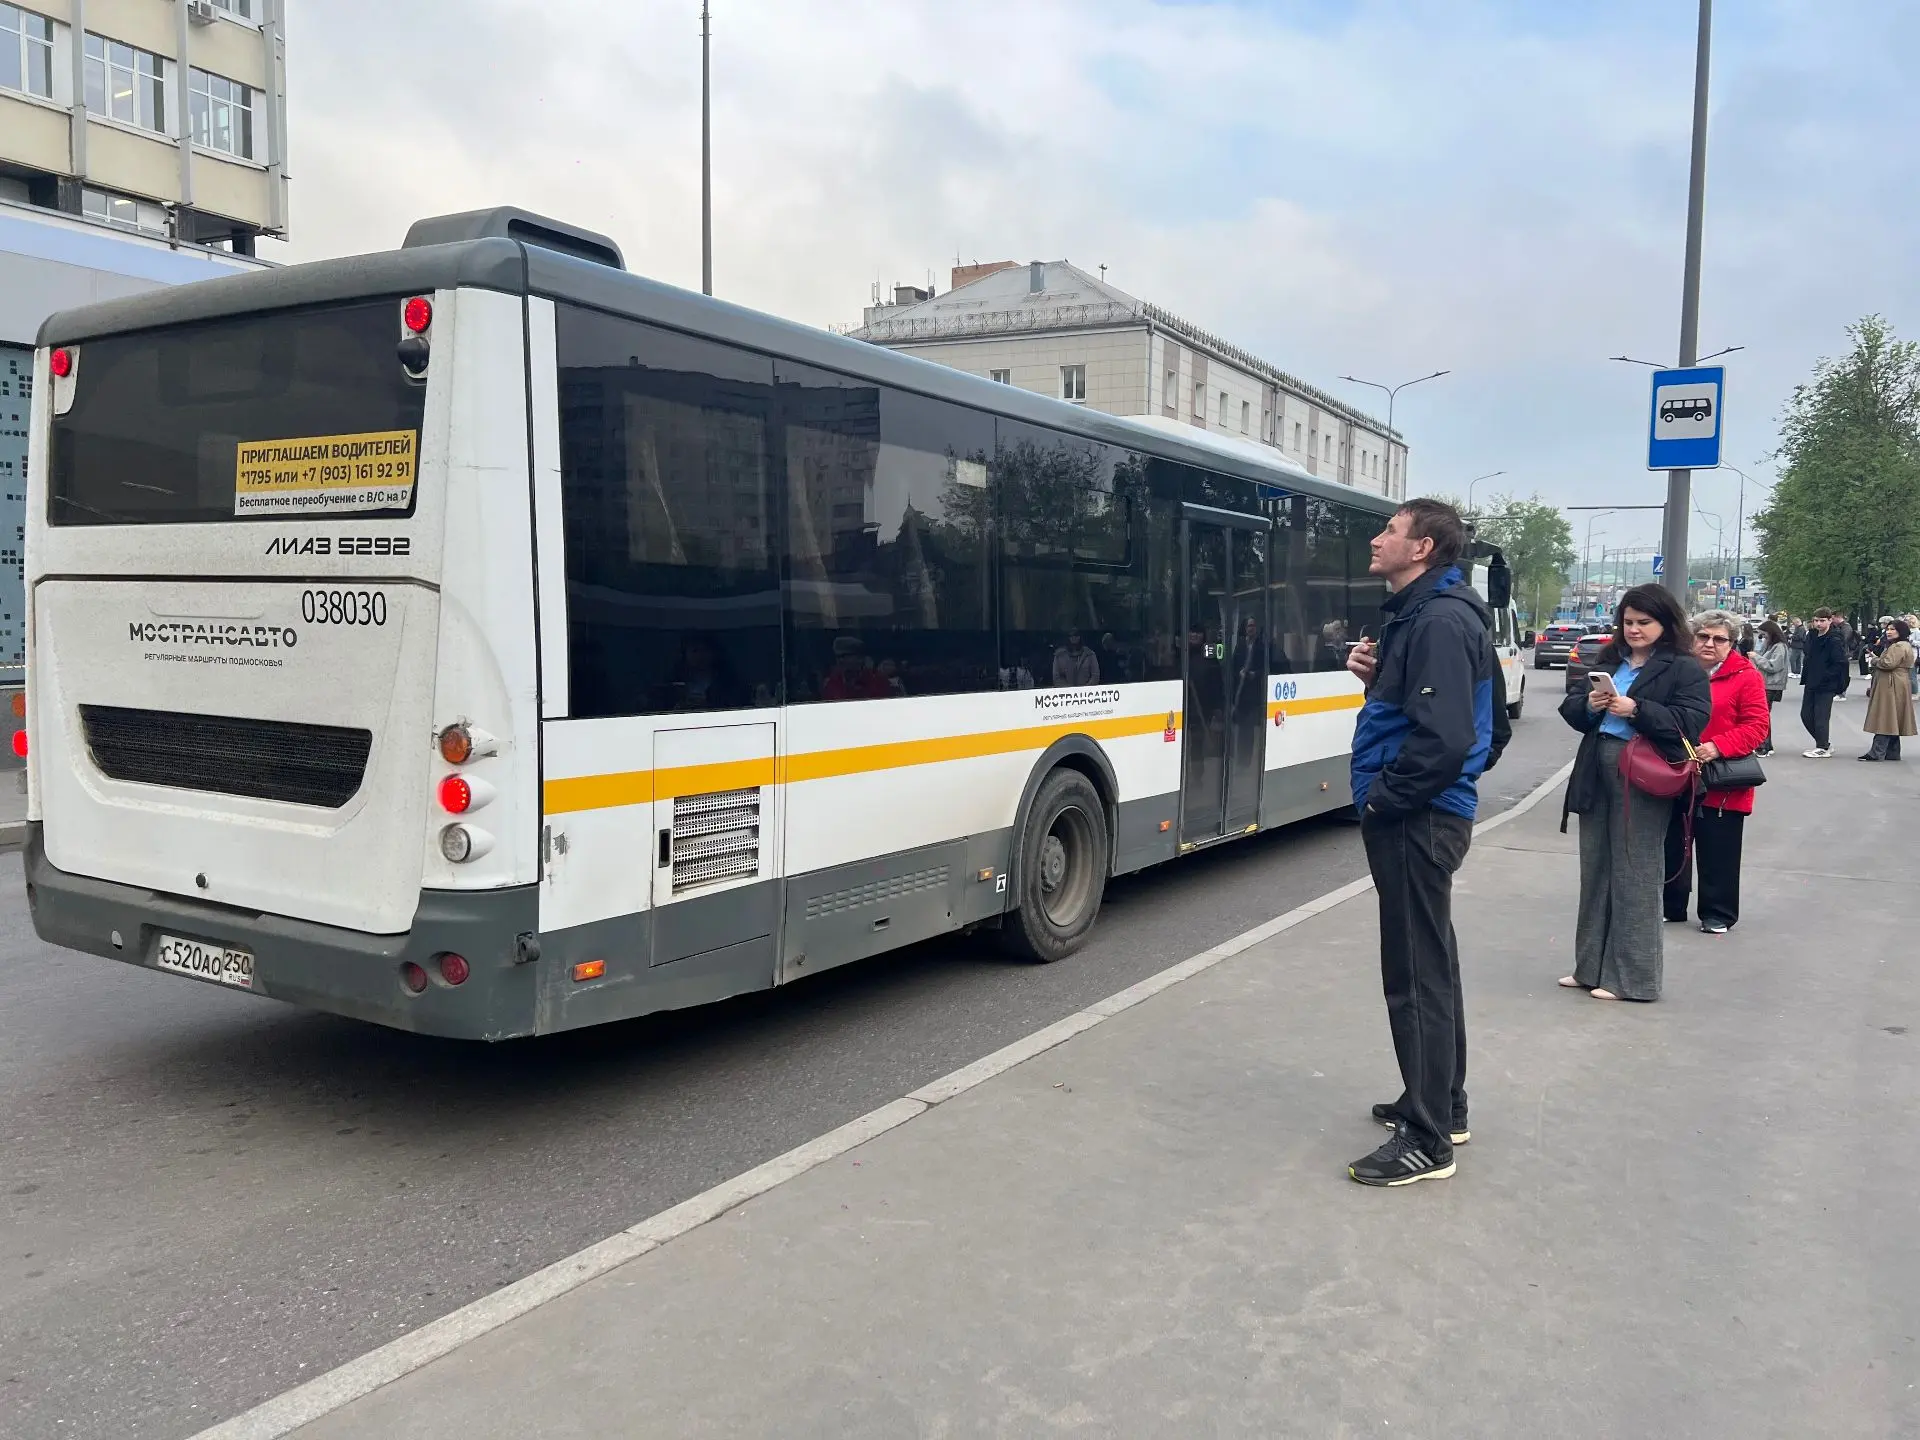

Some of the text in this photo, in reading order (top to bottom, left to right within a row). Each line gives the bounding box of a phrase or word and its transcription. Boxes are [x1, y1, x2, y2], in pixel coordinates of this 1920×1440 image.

[241, 435, 411, 464] ПРИГЛАШАЕМ ВОДИТЕЛЕЙ
[275, 471, 298, 483] или
[302, 468, 317, 482] +7
[320, 465, 351, 484] (903)
[356, 464, 373, 479] 161
[377, 462, 392, 478] 92
[397, 461, 410, 477] 91
[239, 496, 290, 508] Бесплатное
[292, 492, 356, 509] переобучение
[386, 492, 399, 502] на
[401, 490, 408, 500] D
[265, 537, 411, 556] ЛИАЗ 5292
[301, 590, 387, 626] 038030
[129, 622, 298, 648] МОСТРАНСАВТО
[144, 653, 283, 667] РЕГУЛЯРНЫЕ МАРШРУТЫ ПОДМОСКОВЬЯ
[1035, 690, 1120, 709] МОСТРАНСАВТО
[224, 952, 251, 975] 250
[228, 973, 241, 983] RUS
